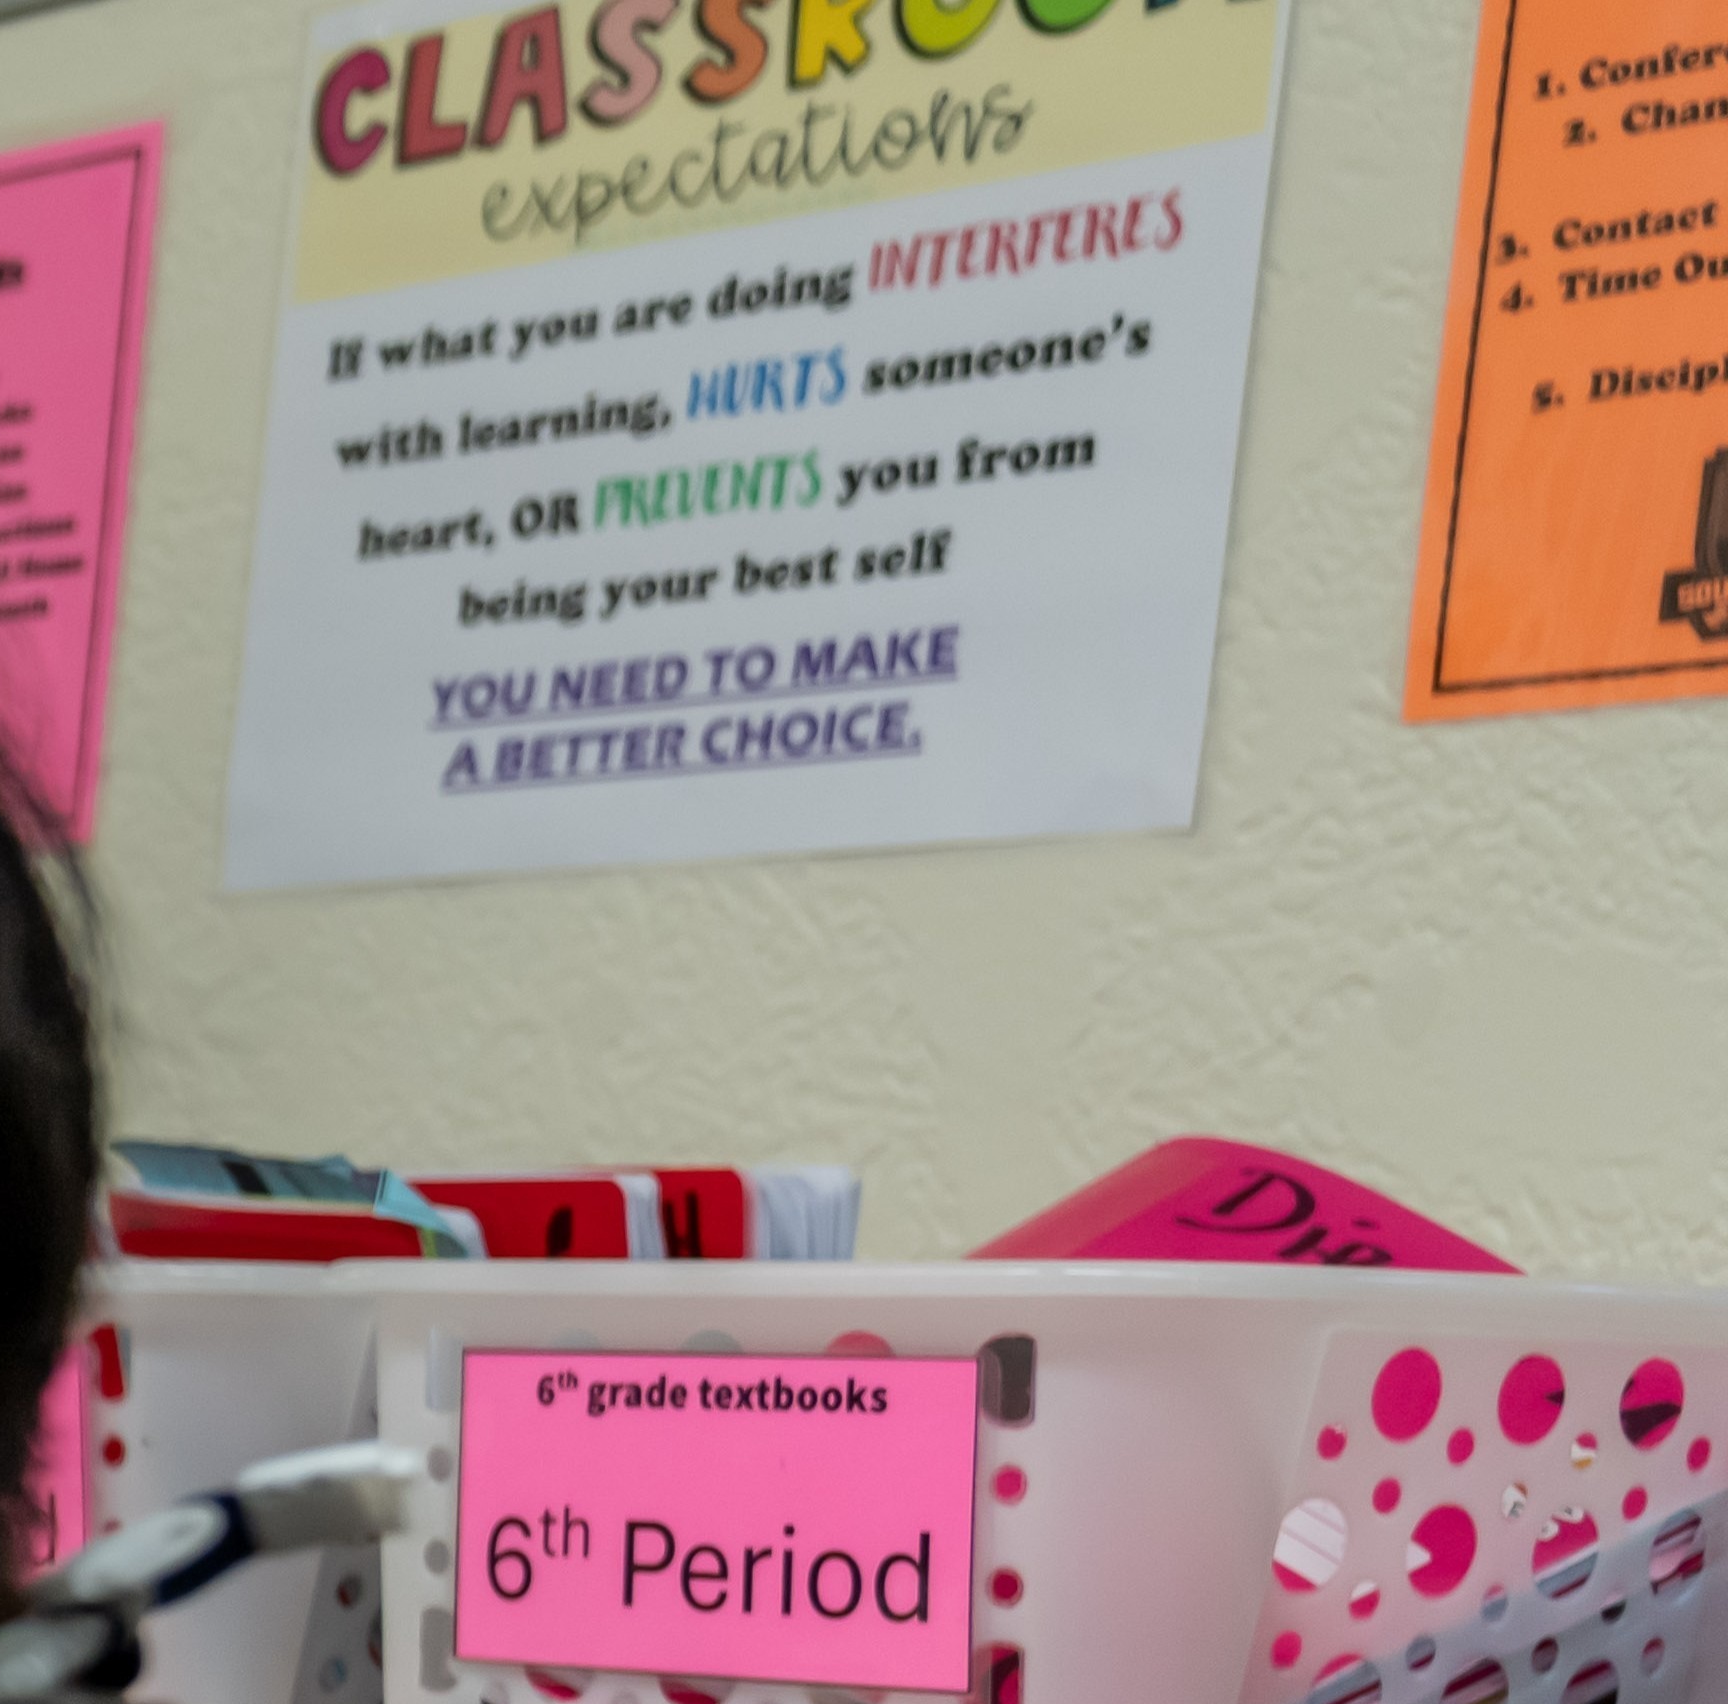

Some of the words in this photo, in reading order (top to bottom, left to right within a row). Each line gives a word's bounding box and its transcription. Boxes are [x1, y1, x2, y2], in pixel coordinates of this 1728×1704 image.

[1579, 43, 1728, 89] Confer
[481, 80, 1034, 246] expectations
[1552, 200, 1718, 250] Contact
[327, 336, 364, 382] If
[378, 321, 497, 370] what
[509, 306, 600, 361] you
[612, 292, 693, 335] are
[706, 262, 855, 319] doing
[868, 188, 1184, 292] INTERFERES
[1558, 266, 1662, 303] Time
[335, 419, 444, 469] with
[458, 391, 673, 442] learning,
[686, 343, 847, 421] HURTS
[862, 311, 1152, 396] someone's
[357, 511, 495, 560] heart,
[510, 494, 580, 539] OR
[594, 448, 822, 529] PREVENTS
[836, 455, 939, 507] you
[954, 430, 1096, 484] from
[458, 582, 586, 627] being
[598, 565, 721, 615] your
[733, 554, 841, 597] best
[853, 529, 953, 577] self
[429, 675, 537, 726] YOU
[550, 655, 688, 711] NEED
[704, 645, 776, 695] TO
[789, 625, 960, 691] MAKE
[441, 740, 483, 790] A
[493, 720, 688, 784] BETTER
[700, 702, 924, 765] CHOICE.
[537, 1370, 579, 1406] 6th
[586, 1373, 688, 1417] grade
[698, 1376, 888, 1415] textbooks
[486, 1505, 590, 1602] 6th
[622, 1520, 931, 1623] Period
